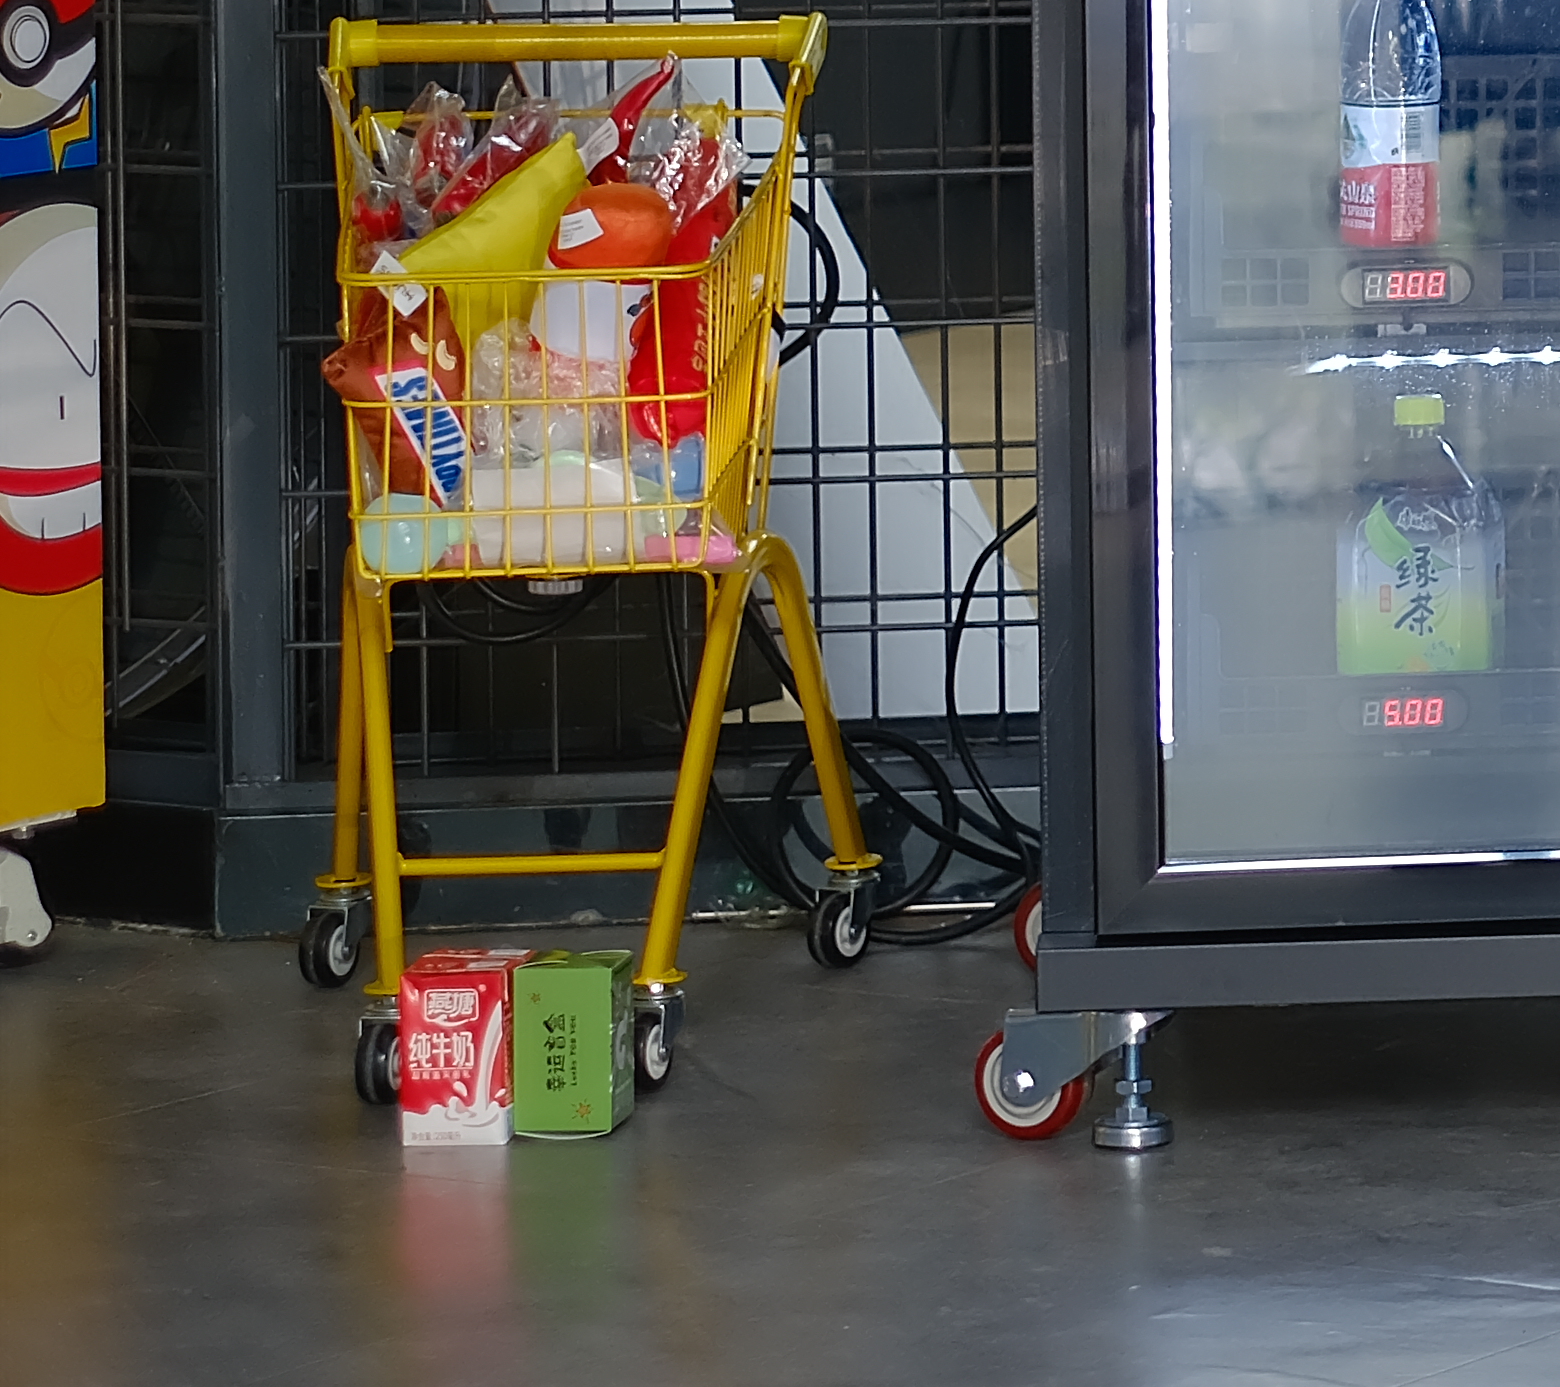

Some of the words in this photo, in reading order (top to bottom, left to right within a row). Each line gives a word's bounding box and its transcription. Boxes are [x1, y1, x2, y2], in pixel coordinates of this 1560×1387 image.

[1394, 544, 1439, 637] 绿茶
[409, 1031, 474, 1069] 纯牛奶
